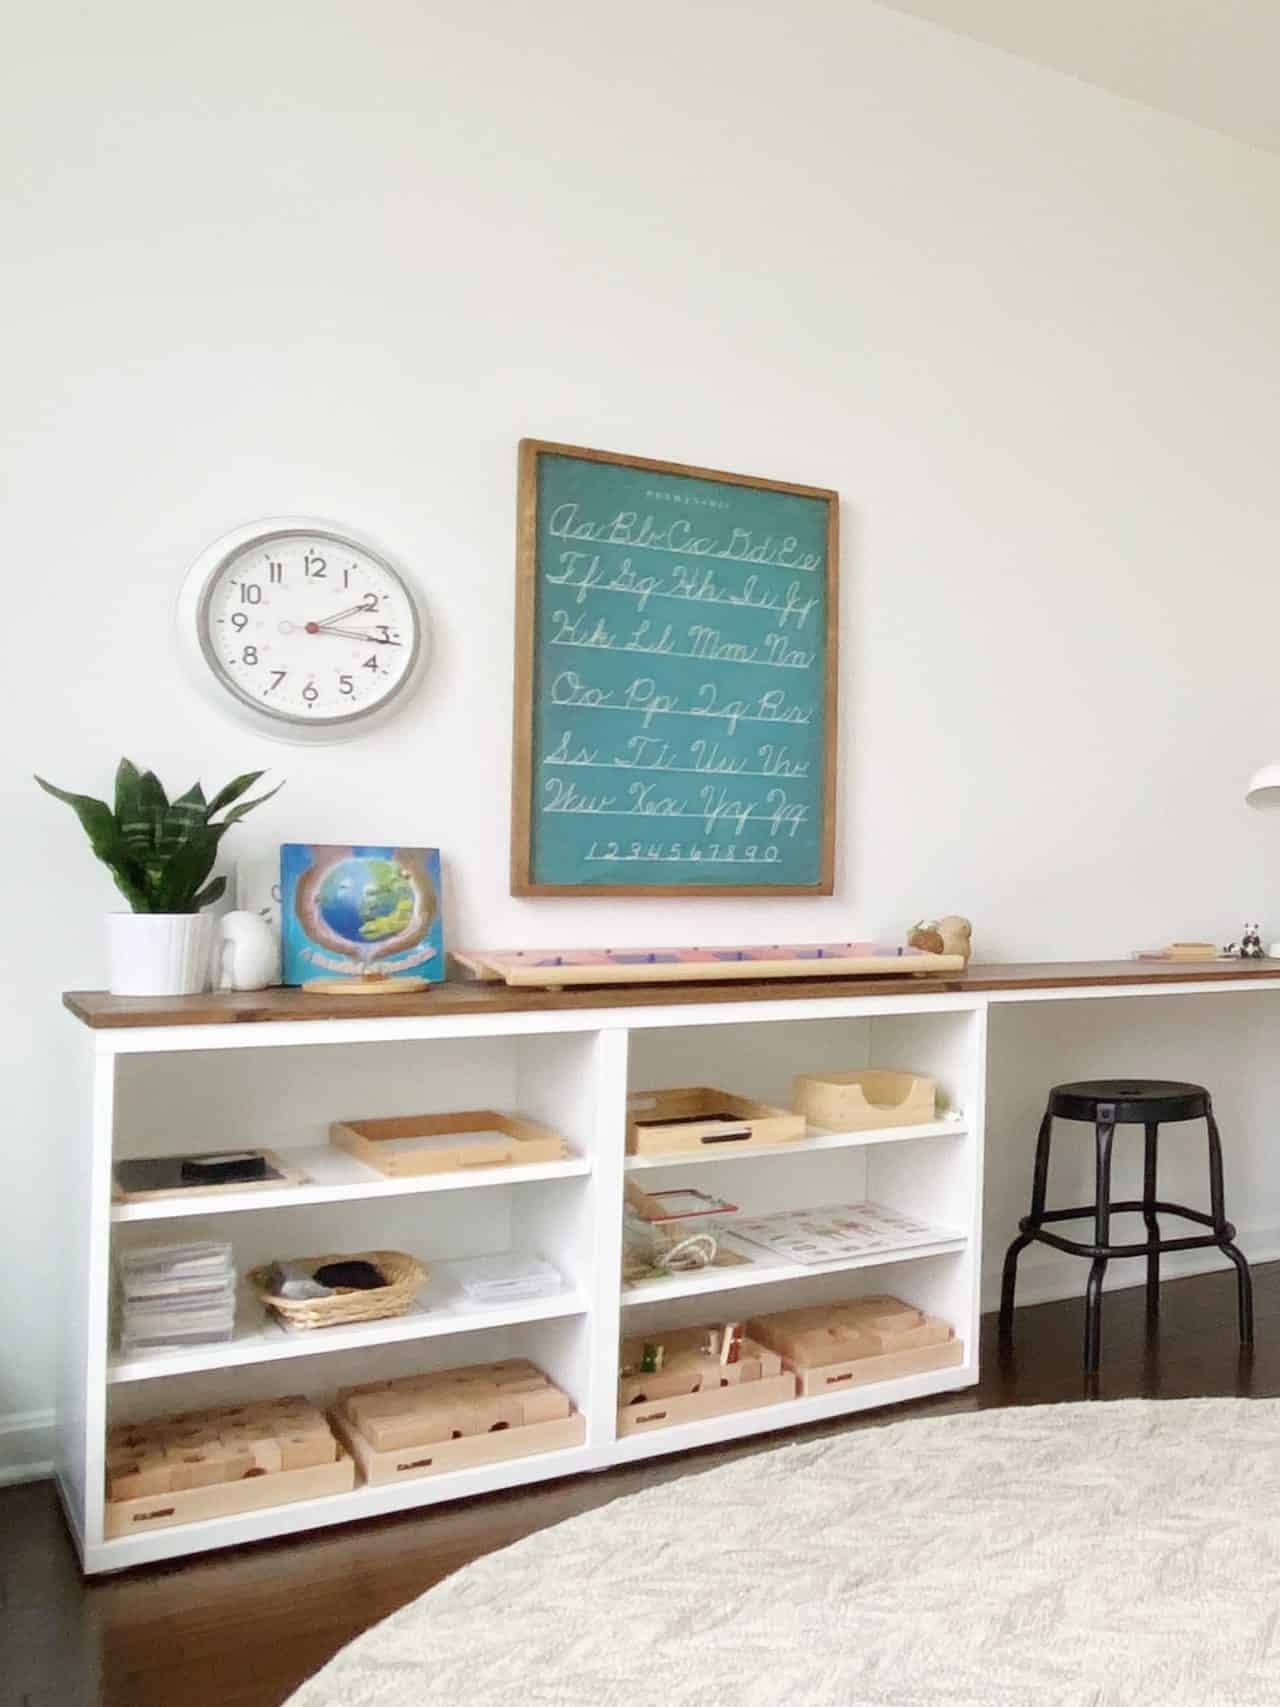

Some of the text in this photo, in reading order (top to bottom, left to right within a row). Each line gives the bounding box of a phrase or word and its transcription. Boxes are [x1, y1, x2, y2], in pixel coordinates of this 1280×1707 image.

[269, 562, 283, 583] 11
[303, 555, 328, 578] 12
[343, 569, 349, 589] 1
[240, 583, 262, 605] 10
[363, 593, 379, 613] 2
[231, 612, 248, 632] 9
[376, 625, 391, 644] 3
[242, 646, 258, 666] 8
[362, 654, 379, 673] 4
[270, 670, 287, 690] 7
[339, 675, 354, 695] 5
[302, 681, 319, 701] 6
